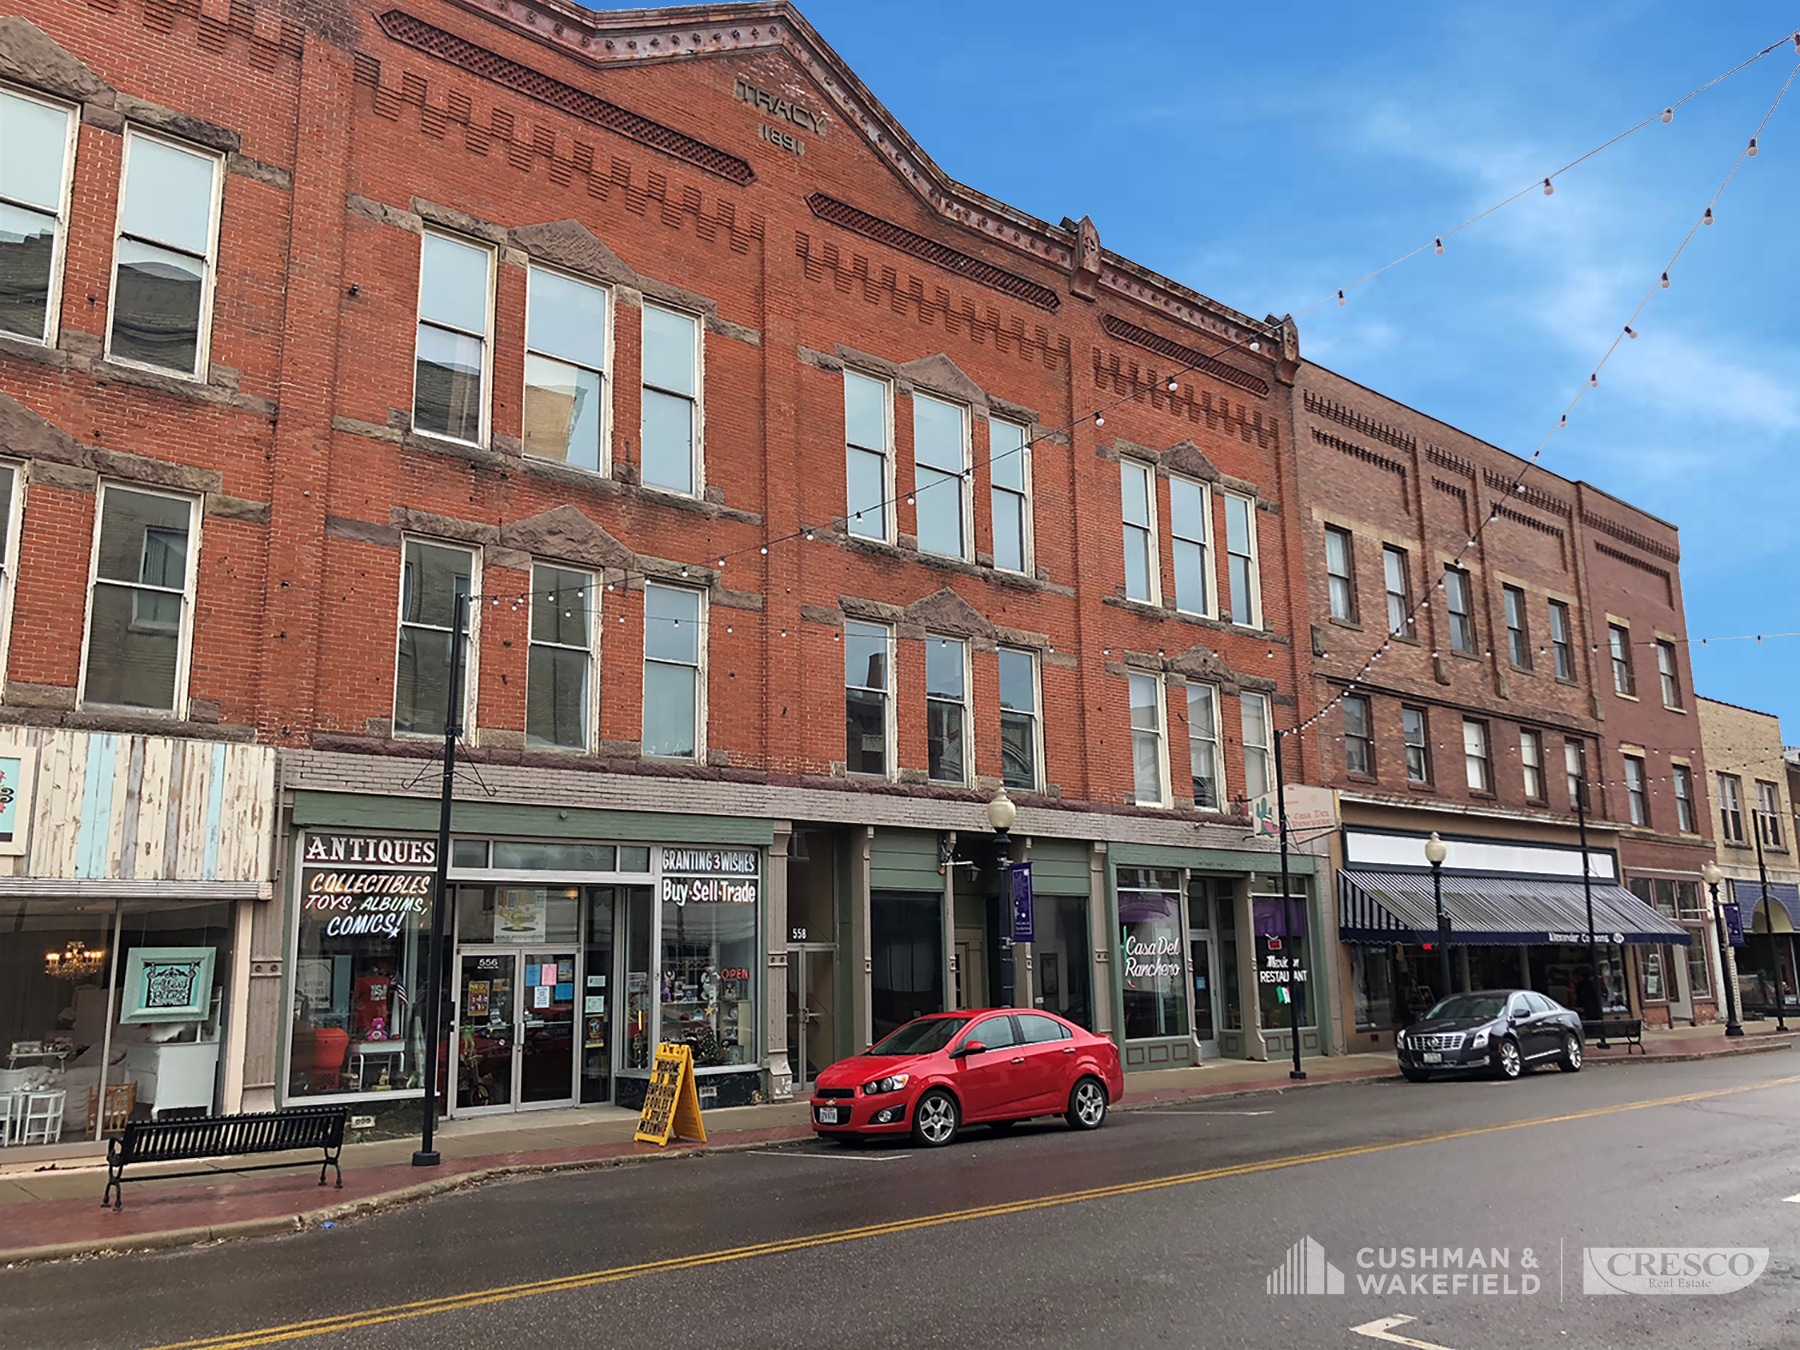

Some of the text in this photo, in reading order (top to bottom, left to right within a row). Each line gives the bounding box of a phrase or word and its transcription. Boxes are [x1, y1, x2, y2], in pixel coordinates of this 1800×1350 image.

[735, 79, 826, 137] TRACY
[305, 836, 436, 864] ANTIQUES
[662, 849, 755, 873] GRANTING 3 WISHES
[310, 872, 431, 894] COLLECTIBLES
[304, 894, 428, 916] TOYS, ALBUMS,
[327, 911, 405, 938] COMICS!
[792, 927, 807, 940] 558
[1125, 935, 1180, 956] Casa Del
[720, 967, 750, 980] OPEN
[1125, 956, 1180, 977] Ranchero
[1260, 970, 1308, 984] RESTAUANT
